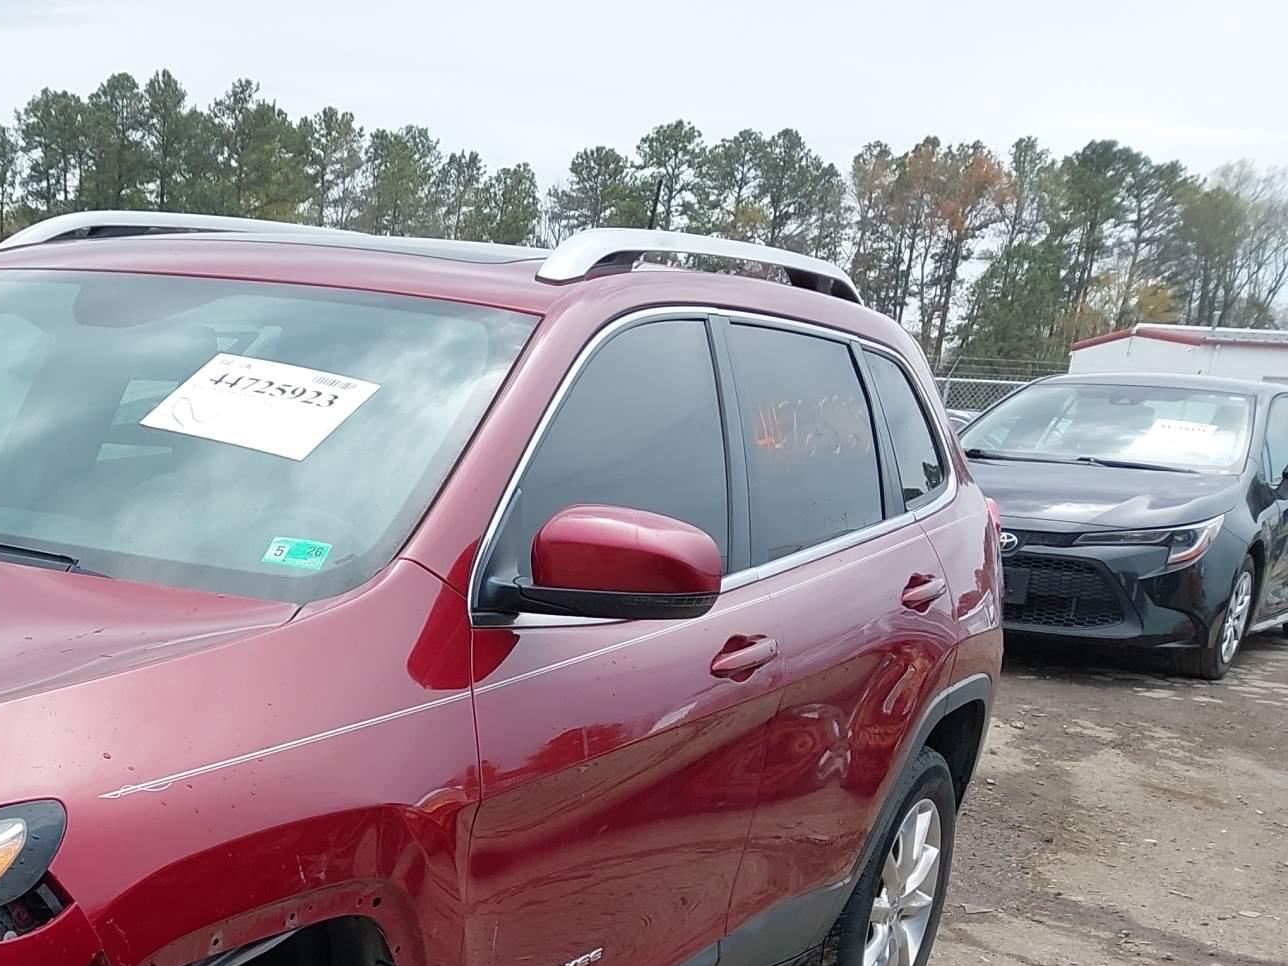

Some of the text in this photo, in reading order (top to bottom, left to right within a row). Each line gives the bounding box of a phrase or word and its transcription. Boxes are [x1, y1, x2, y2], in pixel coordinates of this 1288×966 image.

[209, 372, 340, 408] 44725923
[274, 545, 324, 558] 5 26
